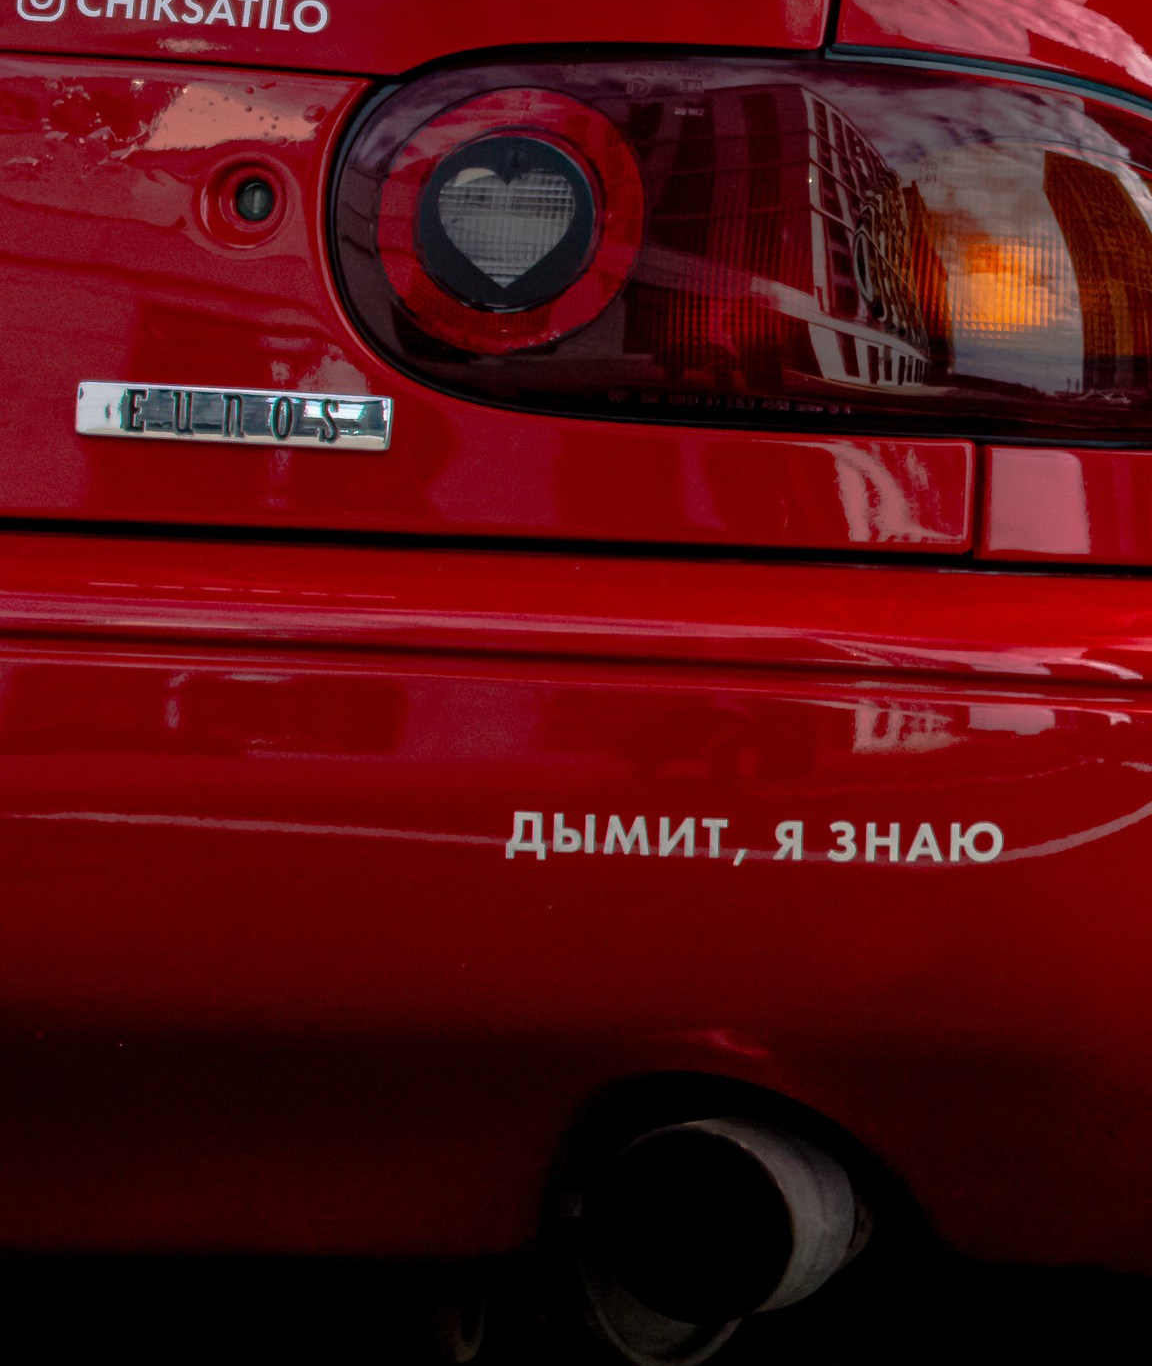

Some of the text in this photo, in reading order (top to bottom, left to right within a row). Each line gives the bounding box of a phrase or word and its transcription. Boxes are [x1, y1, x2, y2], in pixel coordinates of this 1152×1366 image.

[505, 810, 1005, 867] ДЫМИТ, Я ЗНАЮ
